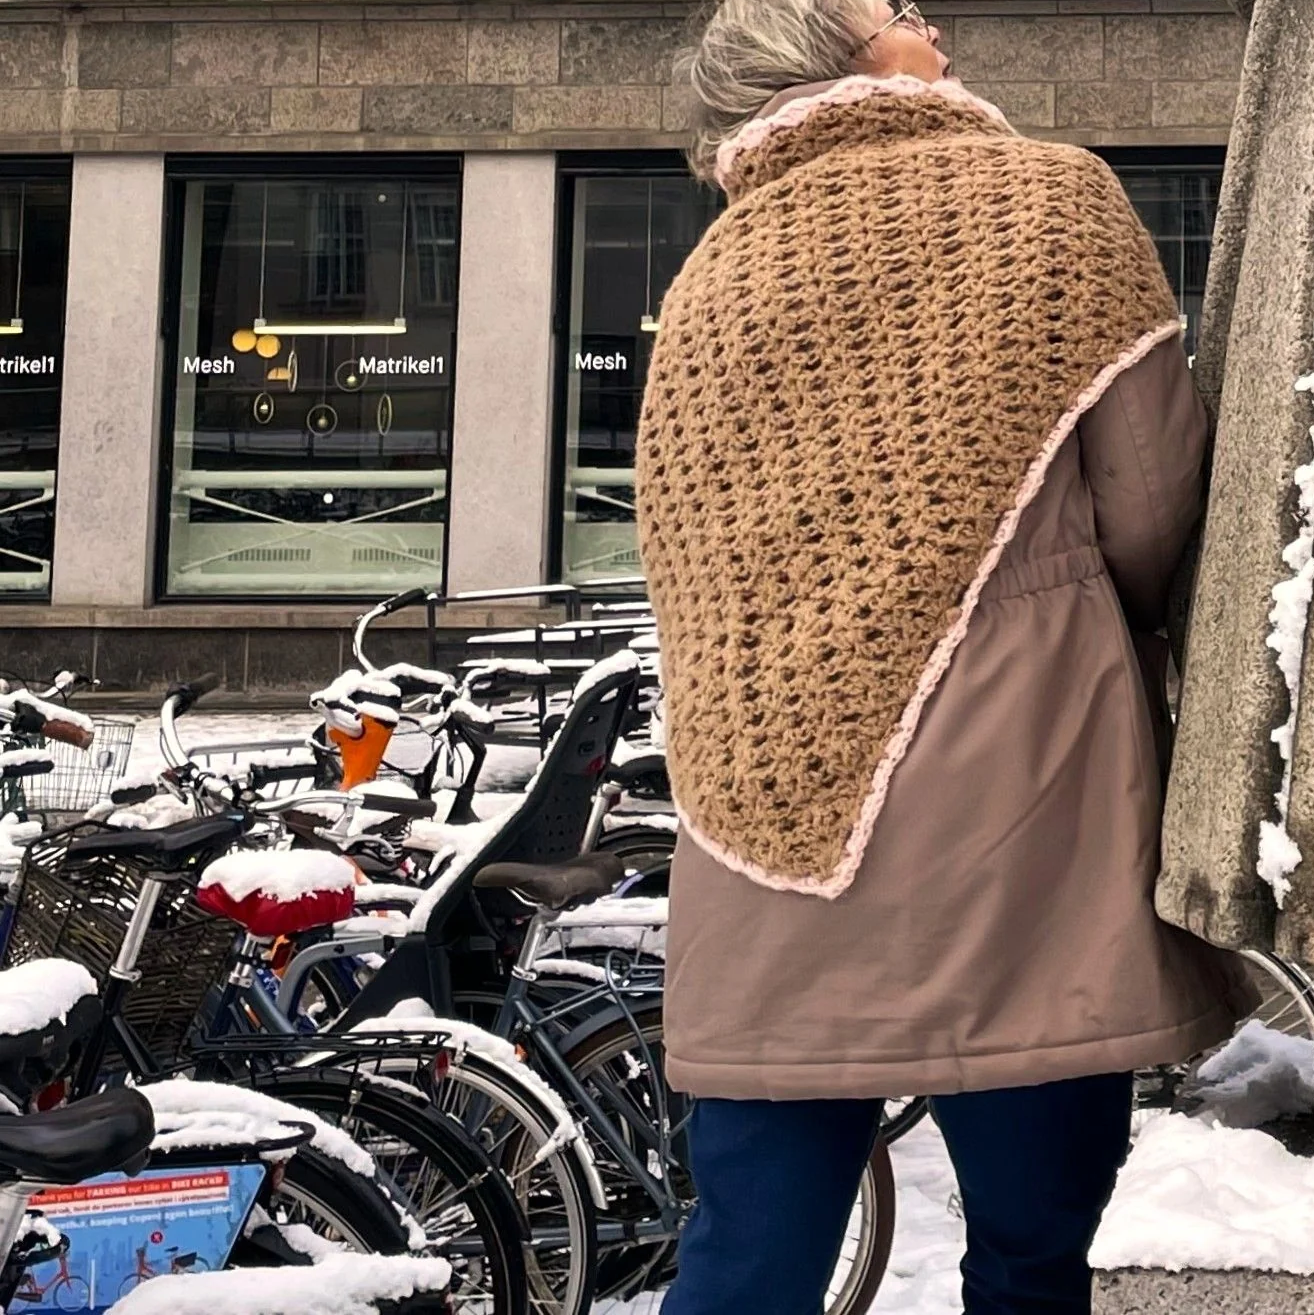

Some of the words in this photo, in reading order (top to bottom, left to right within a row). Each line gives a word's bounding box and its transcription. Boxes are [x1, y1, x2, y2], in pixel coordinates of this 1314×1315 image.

[0, 355, 55, 374] trikel1
[183, 355, 235, 374] Mesh
[359, 355, 444, 374] Matrikel1
[575, 351, 627, 370] Mesh
